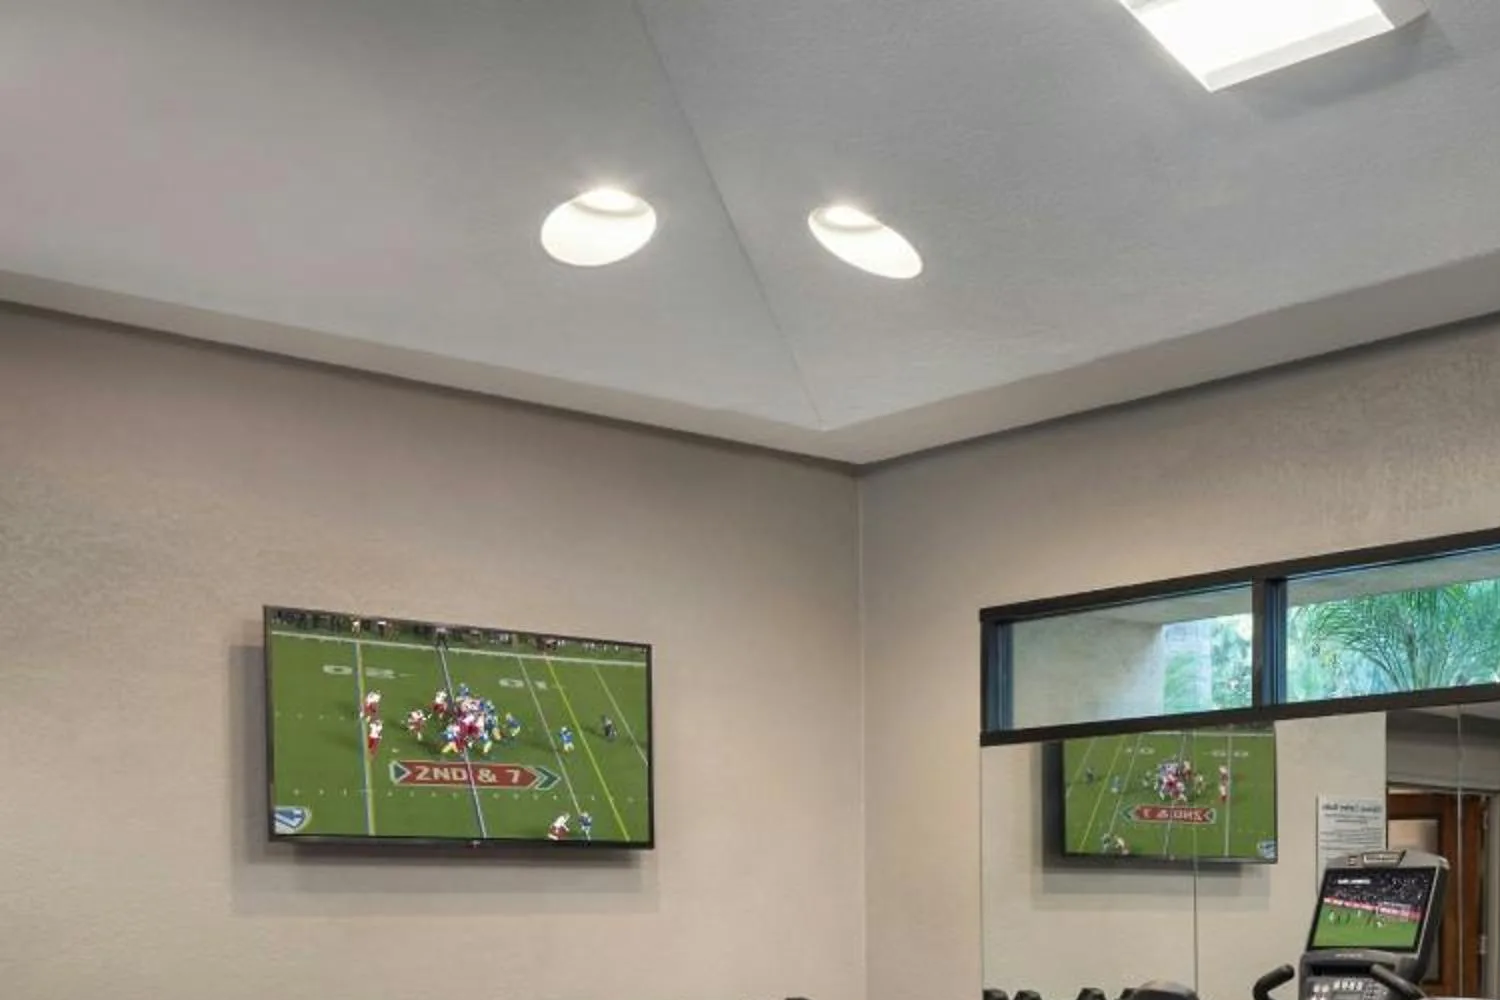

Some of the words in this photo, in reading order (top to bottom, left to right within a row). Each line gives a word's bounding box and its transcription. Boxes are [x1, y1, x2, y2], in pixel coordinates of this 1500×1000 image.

[413, 763, 467, 782] 2ND
[477, 766, 498, 784] &
[506, 768, 523, 784] 7
